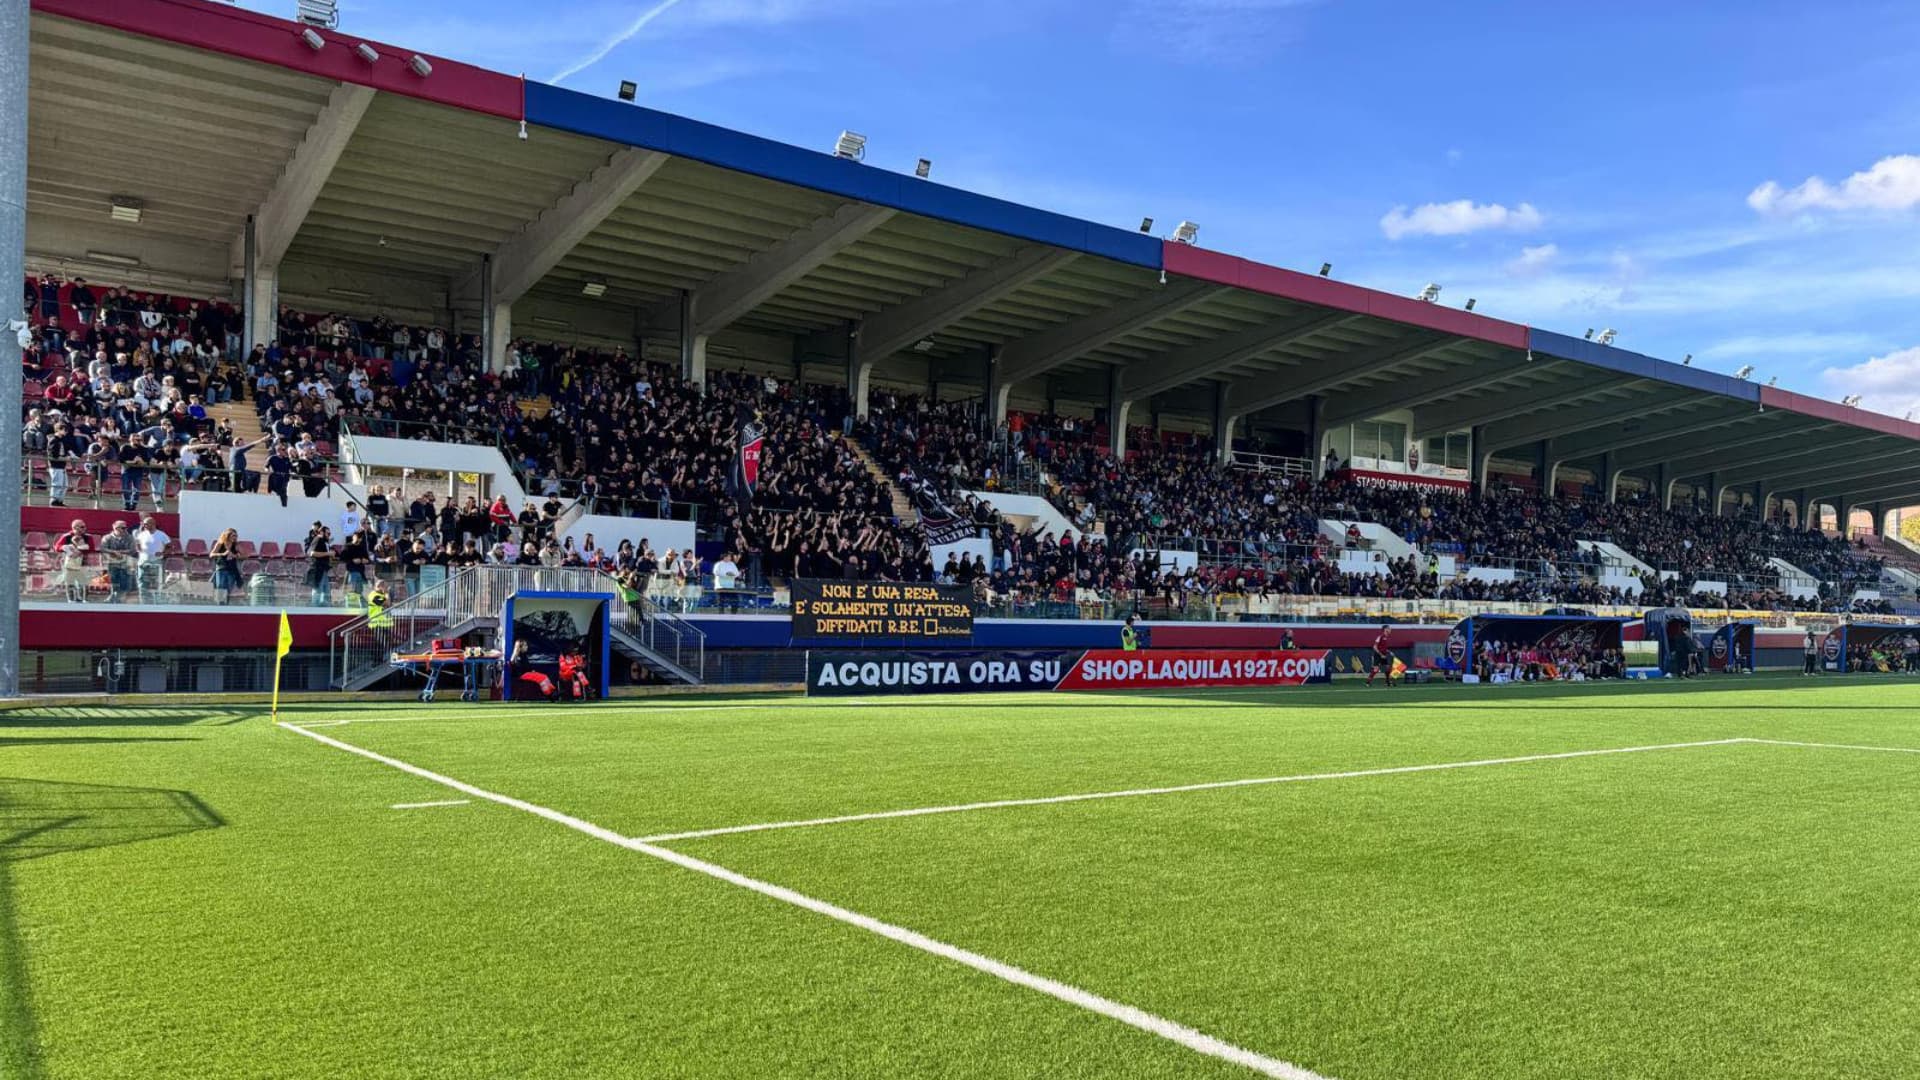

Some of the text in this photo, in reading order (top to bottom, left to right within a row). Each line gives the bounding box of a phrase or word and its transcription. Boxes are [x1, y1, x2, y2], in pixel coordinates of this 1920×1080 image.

[822, 584, 851, 598] NON
[872, 586, 900, 599] UNA
[811, 601, 888, 616] SOLAMENTE
[894, 602, 971, 617] UN'ATTESA
[816, 618, 883, 633] DIFFIDATI
[888, 619, 921, 633] R.B.E.
[818, 657, 1325, 686] ACQUISTA ORA SU SHOP.LAQUILA1927.COM
